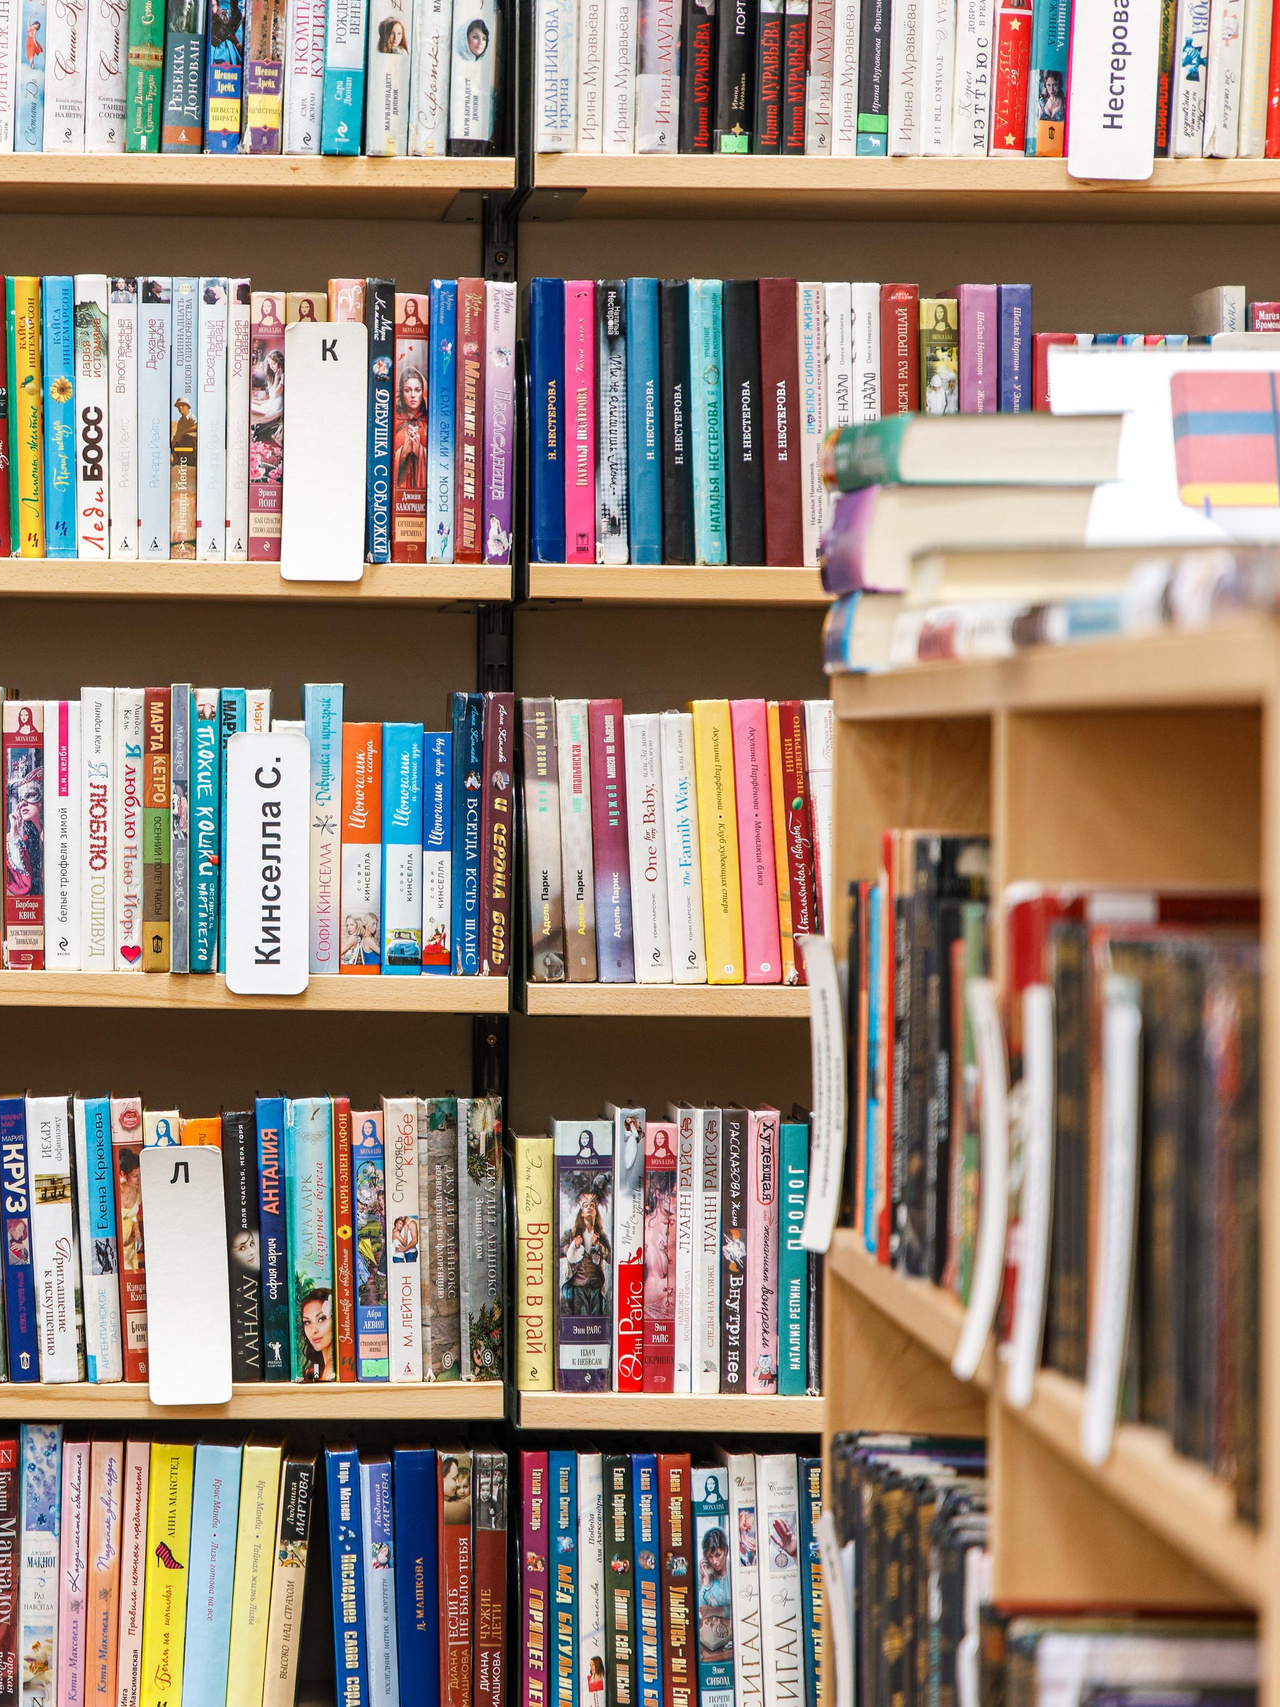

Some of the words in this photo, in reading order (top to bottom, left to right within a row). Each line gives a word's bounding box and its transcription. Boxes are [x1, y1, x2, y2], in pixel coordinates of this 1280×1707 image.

[584, 4, 599, 86] Муравьёва
[695, 23, 710, 103] МУРАВЬЁВА
[1102, 0, 1131, 130] Нестерова
[546, 9, 559, 129] МЕЛЬНИКОВА
[973, 37, 987, 148] МЭТТЬЮС
[560, 78, 569, 128] ирина
[584, 91, 597, 140] Ирина
[696, 107, 709, 147] Ирина
[803, 290, 813, 331] ЖИЗНИ
[895, 308, 907, 356] ПРОЩАЙ
[82, 340, 92, 377] дарья
[92, 318, 101, 377] истомина
[322, 339, 338, 361] К
[805, 334, 815, 385] СИЛЬНЕЕ
[897, 361, 907, 379] РАЗ
[375, 388, 389, 458] ДЕВУШКА
[547, 380, 556, 447] НЕСТЕРОВА
[708, 401, 719, 471] НЕСТЕРОВА
[82, 406, 103, 482] БОСС
[548, 449, 556, 460] Н.
[376, 465, 388, 476] С
[82, 486, 105, 550] Леди
[374, 481, 387, 552] ОБЛОЖКИ
[709, 477, 721, 533] НАТАЛЬЯ
[150, 702, 164, 751] МАРТА
[59, 746, 67, 772] келби
[254, 757, 281, 789] С.
[784, 738, 794, 772] НИКИ
[793, 716, 804, 794] ПЕЛЛЕГРИНО
[152, 756, 166, 803] КЕТРО
[676, 777, 690, 812] Way,
[59, 808, 68, 839] зимой
[642, 784, 657, 824] Baby,
[646, 846, 658, 882] One
[677, 815, 693, 867] Family
[59, 843, 69, 888] трюфели
[254, 802, 282, 965] Кинселла
[575, 869, 585, 901] Паркс
[683, 871, 691, 887] The
[58, 892, 68, 923] белые
[576, 903, 586, 935] Адель
[93, 1113, 106, 1181] Крюкова
[339, 1114, 348, 1150] ЛАФОН
[3, 1144, 26, 1212] КРУЗ
[171, 1162, 189, 1184] Л
[261, 1129, 279, 1214] АНТАЛИЯ
[338, 1153, 348, 1214] МАРИ-ЭЛЕН
[704, 1145, 716, 1188] РАЙС
[95, 1187, 107, 1229] Елена
[704, 1196, 717, 1255] ЛУАНН
[787, 1165, 804, 1250] ПРОЛОГ
[520, 1223, 549, 1286] Врата
[399, 1276, 412, 1328] ЛЕЙТОН
[529, 1296, 542, 1306] в
[618, 1282, 642, 1335] Райс
[789, 1279, 801, 1319] РЕПИНА
[402, 1331, 412, 1347] М.
[520, 1314, 548, 1354] рай
[790, 1323, 801, 1370] НАТАЛИЯ
[618, 1339, 642, 1381] Энн
[169, 1456, 180, 1506] МАКСТЕД
[168, 1509, 177, 1538] АННА
[481, 1589, 491, 1640] ЧУЖИЕ
[492, 1604, 502, 1640] ДЕТИ
